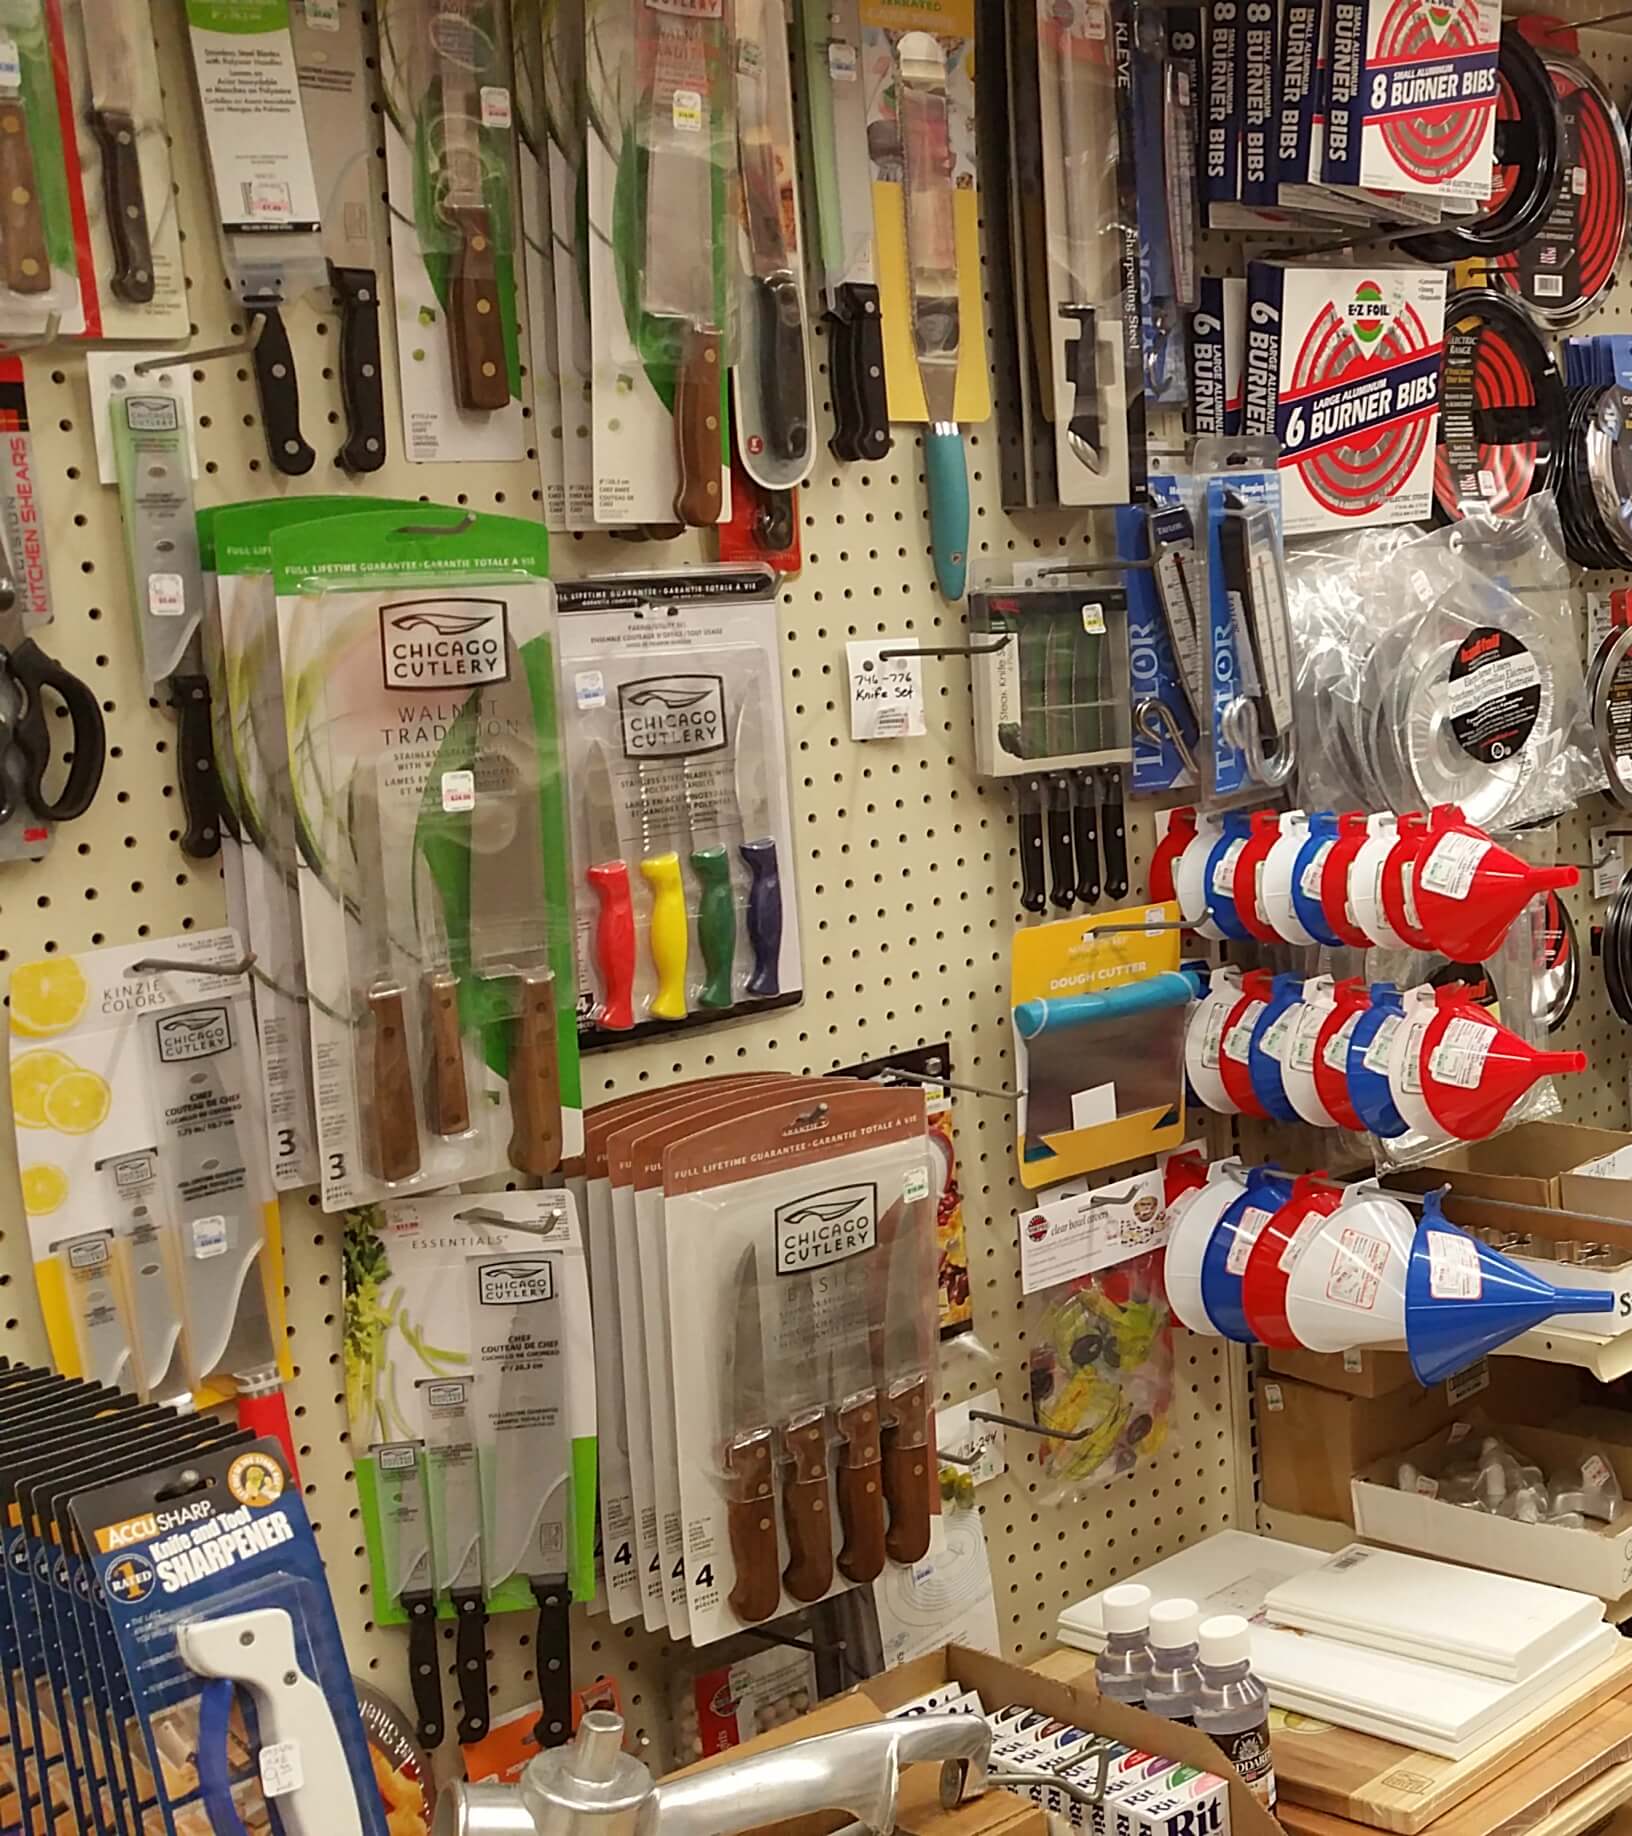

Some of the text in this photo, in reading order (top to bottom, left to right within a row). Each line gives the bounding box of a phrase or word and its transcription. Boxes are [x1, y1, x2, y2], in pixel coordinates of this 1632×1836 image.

[1214, 2, 1236, 21] 8
[1247, 4, 1271, 23] 8
[1172, 32, 1195, 50] 8
[1301, 8, 1315, 95] SMALL ALUMINUM
[1350, 6, 1362, 96] SMALL ALUMINUM
[1264, 31, 1272, 118] SMALL ALUMINUM
[1279, 7, 1306, 159] BURNER BIBS
[1329, 4, 1353, 161] BURNER BIBS
[1394, 64, 1454, 81] SMALL ALUMINUM
[1226, 60, 1234, 114] ALUMINUM
[1371, 74, 1387, 110] 8
[1391, 68, 1496, 106] BURNER BIBS
[1208, 28, 1228, 177] BURNER BIBS
[1247, 30, 1264, 182] BURNER BIBS
[1124, 229, 1139, 350] Sharpening Steel
[1251, 301, 1279, 325] 6
[1367, 304, 1389, 317] FOIL
[1193, 313, 1221, 336] 6
[1269, 335, 1279, 375] LARGE
[1195, 343, 1215, 435] BURNE
[1213, 344, 1223, 435] LARGE ALUMINU
[1246, 333, 1267, 436] BURNER
[1313, 379, 1387, 411] LARGE ALUMINUM
[1310, 372, 1437, 441] BURNER BIBS
[1286, 407, 1305, 449] 6
[10, 437, 47, 614] KITCHEN SHEARS
[285, 566, 309, 576] FULL
[312, 563, 357, 574] LIFETIME
[360, 561, 417, 572] GUARANTEE
[423, 558, 470, 569] GARANTIE
[474, 557, 510, 567] TOTALE
[571, 591, 607, 600] LIFETIME
[610, 588, 657, 598] GUARANTEE
[663, 585, 703, 595] GARANTIE
[705, 583, 733, 593] TOTALE
[393, 638, 498, 660] CHICAGO
[394, 657, 498, 678] CUTLERY
[855, 685, 915, 701] Knife Set
[1129, 618, 1165, 777] TALOR
[1214, 622, 1238, 779] TALOR
[630, 710, 717, 732] CHICAGO
[632, 727, 717, 748] CUTLERY
[1051, 961, 1147, 990] DOUGH CUTTER
[103, 979, 162, 1000] KINZIE
[102, 992, 167, 1014] COLORS
[164, 1027, 225, 1047] CHICAGO
[165, 1038, 225, 1057] CUTLERY
[190, 1091, 213, 1101] CHEF
[165, 1102, 205, 1117] COUTEAU
[278, 1129, 297, 1157] 3
[675, 1115, 917, 1180] FULL LIFETIME GUARANTEE GARANTIE TOTALE VIE
[328, 1153, 346, 1181] 3
[412, 1235, 504, 1249] ESSENTIALS
[783, 1216, 869, 1250] CHICAGO
[784, 1231, 869, 1265] CUTLERY
[485, 1279, 547, 1291] CHICAGO
[486, 1288, 547, 1300] CUTLERY
[481, 1340, 559, 1354] COUTEAU DE CHEF
[508, 1334, 531, 1343] CHEF
[108, 1500, 212, 1550] ACCUSHARP
[149, 1505, 252, 1562] Knife and Tool
[155, 1511, 294, 1593] SHARPENER
[613, 1541, 632, 1566] 4
[112, 1569, 153, 1592] RATED
[117, 1562, 145, 1599] 1
[696, 1563, 714, 1588] 4
[993, 1740, 1026, 1758] Rit
[1012, 1747, 1044, 1764] Rit
[1078, 1775, 1098, 1790] Ri
[1104, 1778, 1133, 1796] Rit
[1123, 1788, 1157, 1807] Rit
[1148, 1796, 1182, 1817] Rit
[1165, 1796, 1222, 1836] Rit
